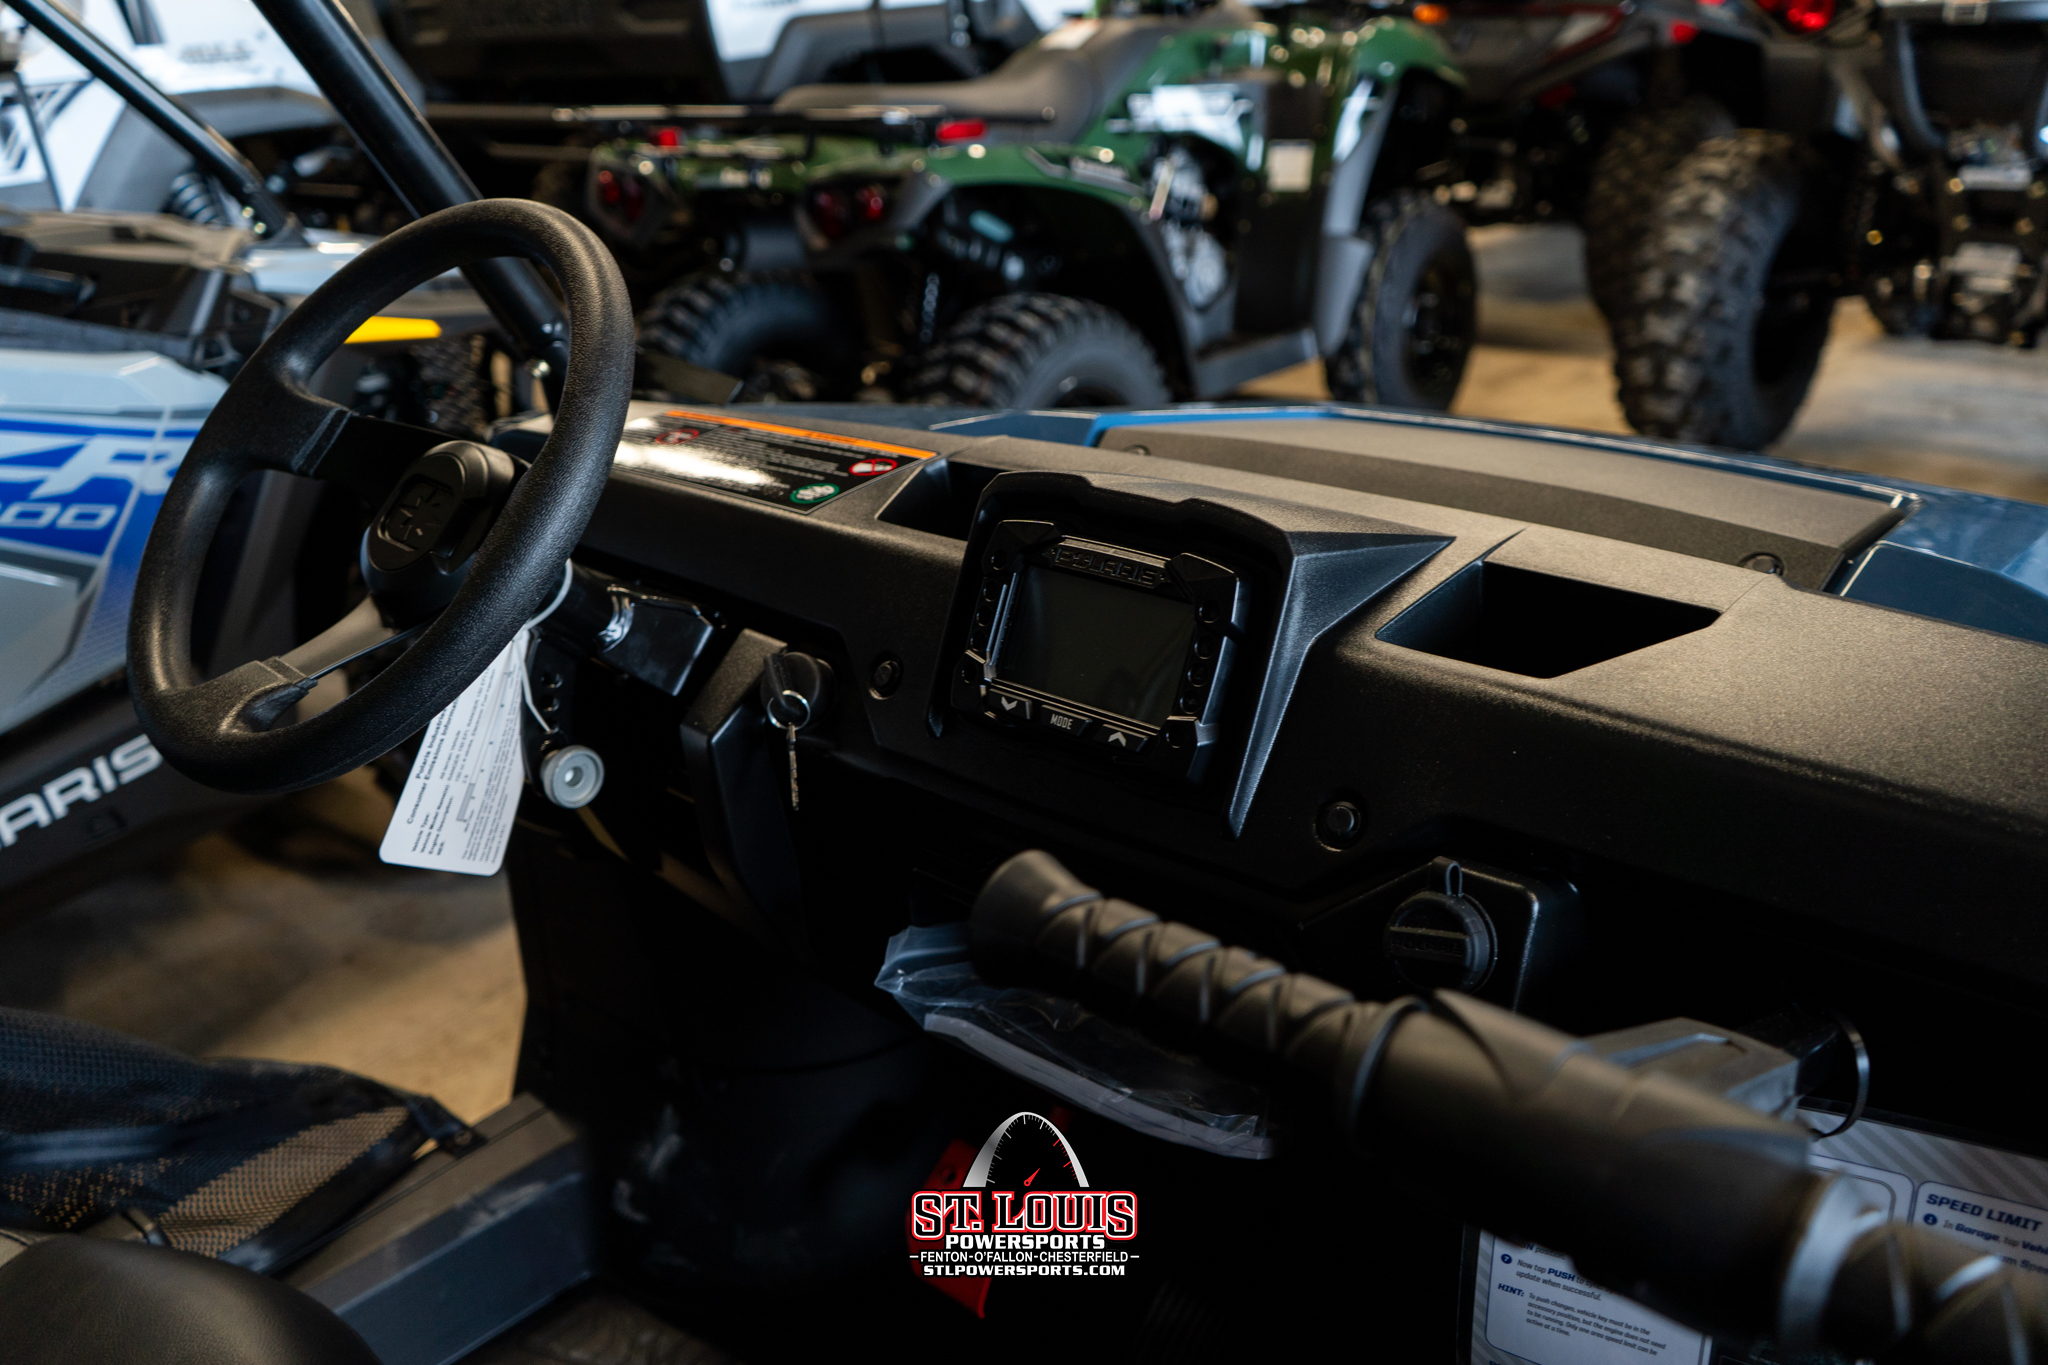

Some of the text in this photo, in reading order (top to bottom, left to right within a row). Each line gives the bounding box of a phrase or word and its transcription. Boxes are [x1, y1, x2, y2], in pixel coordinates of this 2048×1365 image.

[1054, 548, 1159, 586] POLARIS
[1050, 714, 1073, 730] MODE
[415, 750, 430, 779] Polaris
[406, 782, 427, 824] Consumer
[423, 738, 444, 780] Emissions
[1927, 1194, 2042, 1231] SPEED LIMIT
[1515, 1271, 1541, 1282] update
[1541, 1278, 1561, 1288] when
[1562, 1284, 1601, 1300] successful.
[1517, 1259, 1533, 1269] Now
[1533, 1264, 1546, 1274] tap
[1547, 1268, 1575, 1281] PUSH
[1576, 1276, 1584, 1284] to
[1497, 1283, 1524, 1296] HINT:
[1527, 1302, 1556, 1315] accessory
[1581, 1318, 1592, 1326] but
[1603, 1326, 1623, 1336] engine
[1624, 1332, 1638, 1340] does
[1650, 1341, 1666, 1349] need
[1535, 1296, 1550, 1304] push
[1576, 1309, 1597, 1319] vehicle
[1597, 1314, 1608, 1323] key
[1608, 1318, 1624, 1327] must
[1525, 1318, 1543, 1327] active
[1555, 1327, 1570, 1336] time.
[1565, 1321, 1578, 1331] Only
[1590, 1330, 1604, 1338] area
[1604, 1335, 1622, 1345] speed
[1622, 1340, 1636, 1349] limit
[1637, 1345, 1648, 1353] can
